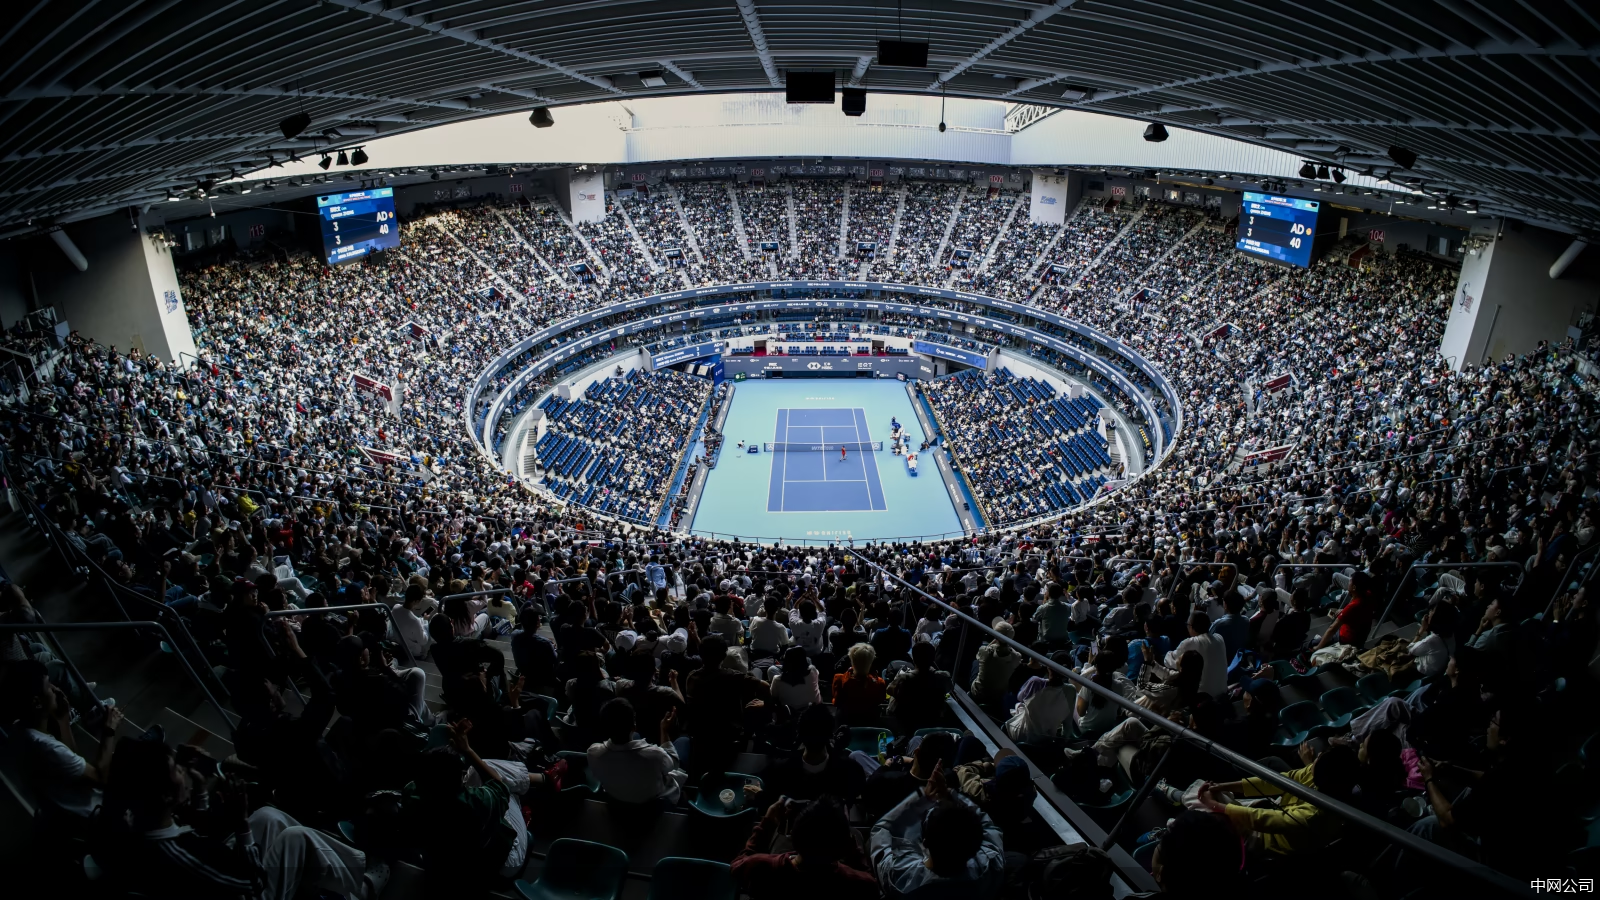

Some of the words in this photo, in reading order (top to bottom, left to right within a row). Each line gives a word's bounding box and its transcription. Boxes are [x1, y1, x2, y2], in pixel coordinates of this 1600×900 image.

[376, 211, 388, 222] AD
[1248, 216, 1254, 225] 3
[250, 224, 265, 237] 113
[332, 221, 339, 231] 3
[379, 224, 389, 234] 40
[1290, 223, 1305, 235] AD
[1247, 228, 1252, 237] 3
[1370, 229, 1384, 242] 104
[335, 235, 341, 245] 3
[1289, 237, 1301, 249] 40
